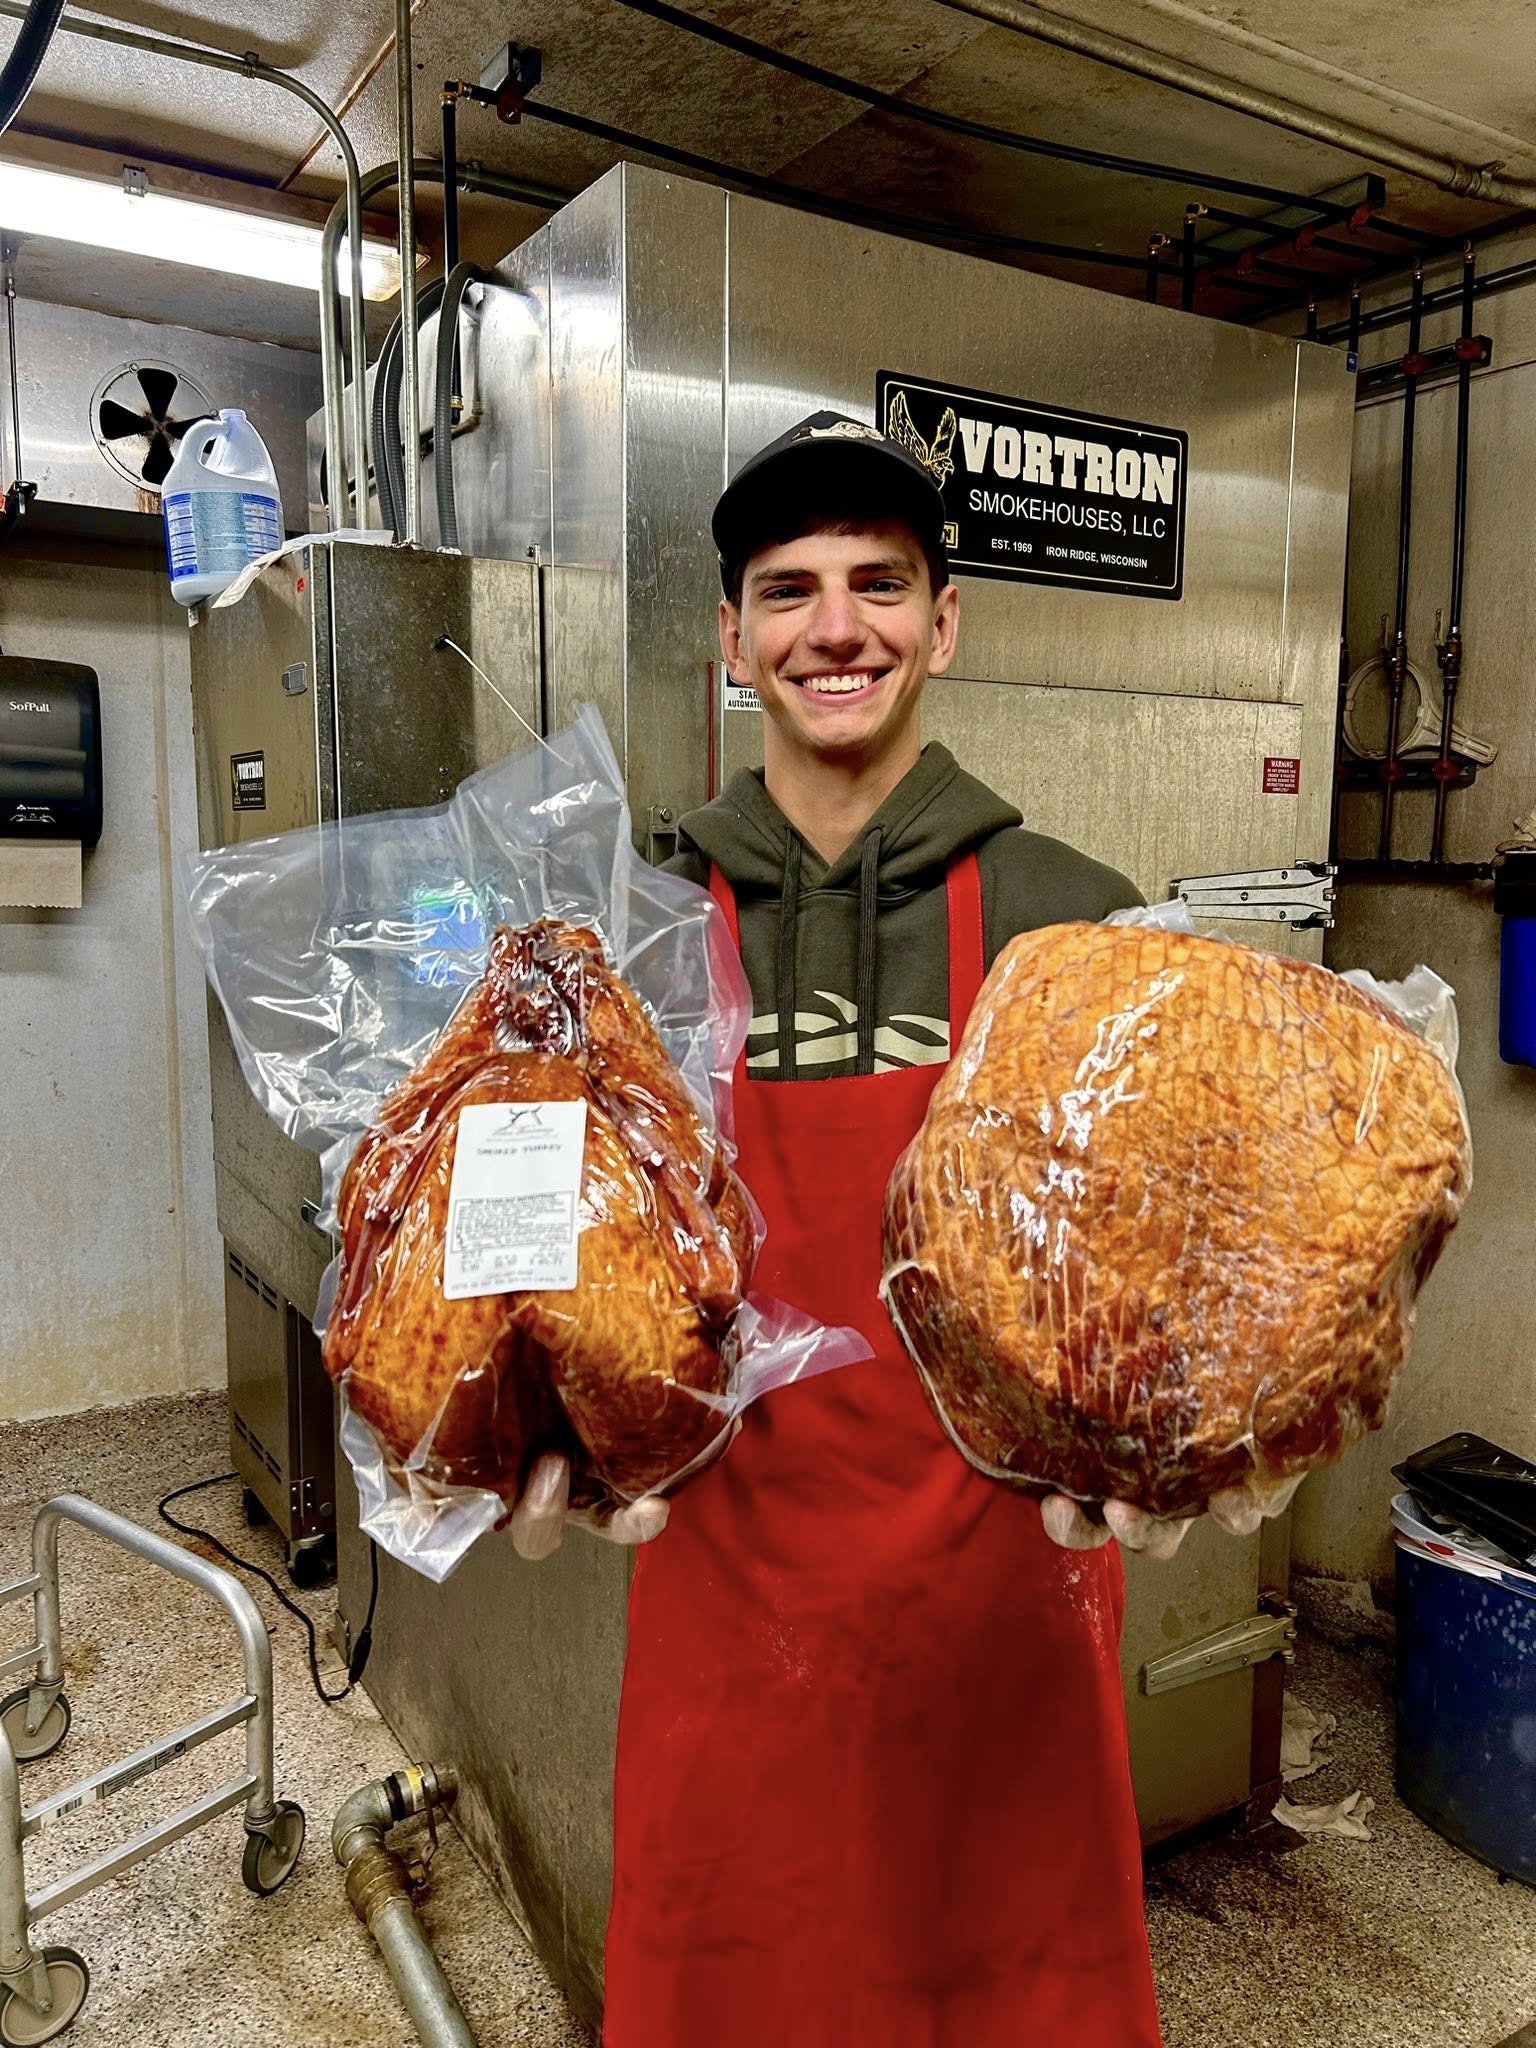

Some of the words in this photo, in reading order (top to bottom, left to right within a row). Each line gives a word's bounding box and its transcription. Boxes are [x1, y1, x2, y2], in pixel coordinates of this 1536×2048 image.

[959, 417, 1176, 505] VORTRON
[969, 489, 1127, 536] SMOKEHOUSES,
[1132, 514, 1166, 539] LLC
[991, 538, 1011, 551] EST.
[1013, 541, 1033, 554] 1969
[1046, 545, 1068, 559] IRON
[1070, 549, 1099, 564] RIDGE,
[1100, 553, 1148, 569] WISCONSIN
[9, 700, 51, 713] SofPull
